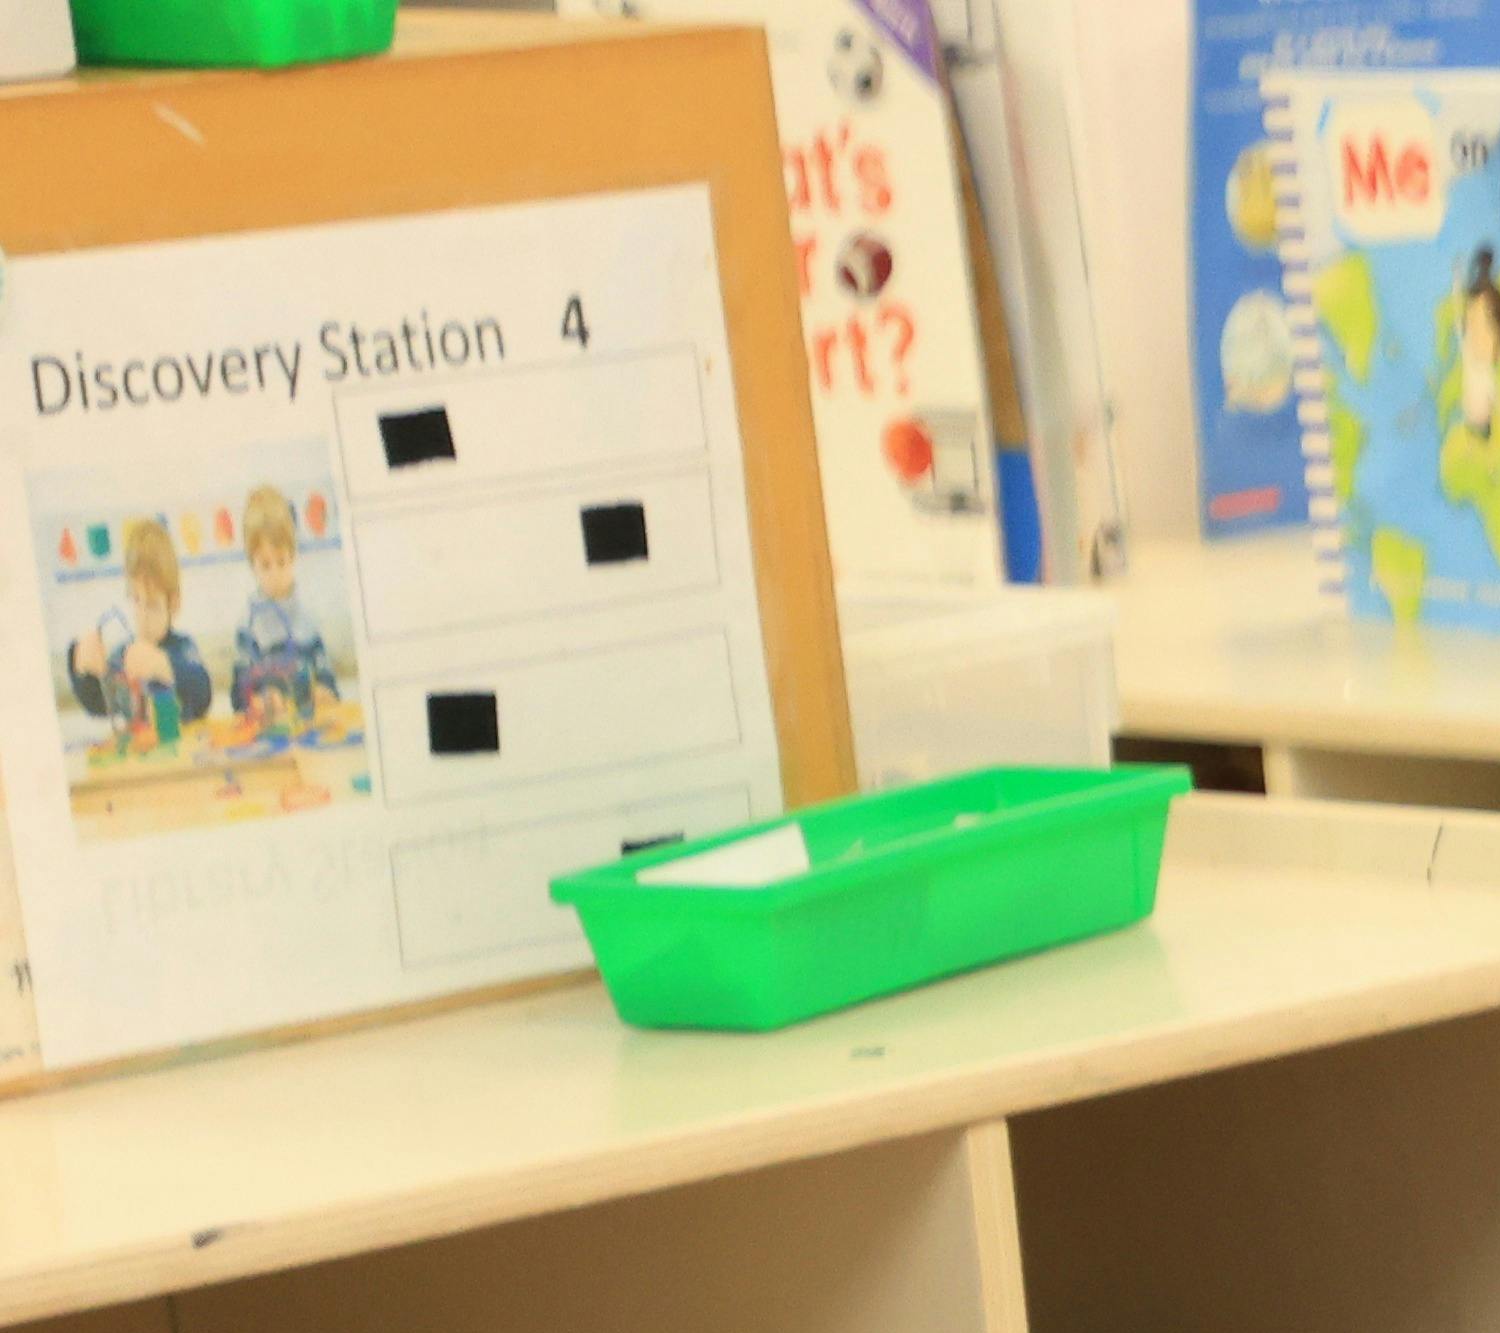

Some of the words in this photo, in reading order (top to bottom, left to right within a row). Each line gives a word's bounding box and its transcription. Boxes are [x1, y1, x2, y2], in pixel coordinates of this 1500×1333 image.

[1340, 133, 1431, 208] Me
[30, 338, 302, 417] Discovery
[318, 311, 507, 384] Station
[560, 295, 591, 350] 4
